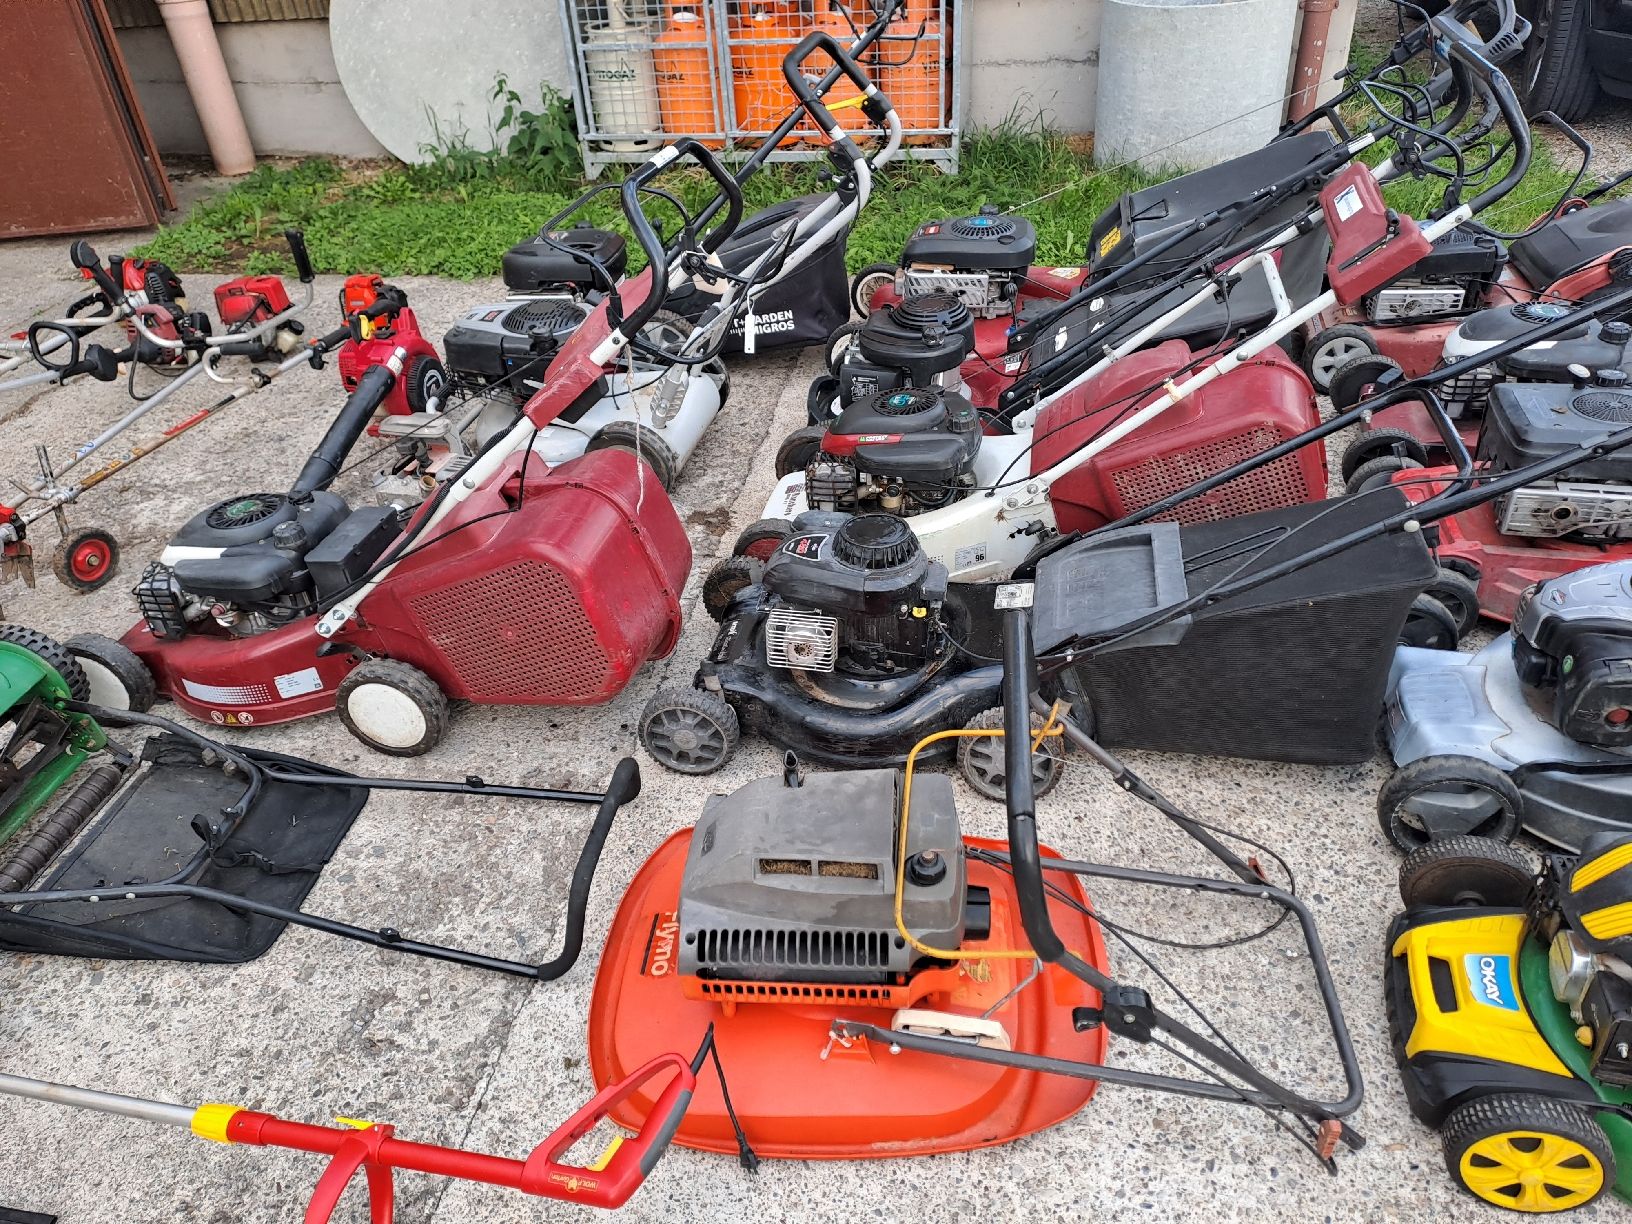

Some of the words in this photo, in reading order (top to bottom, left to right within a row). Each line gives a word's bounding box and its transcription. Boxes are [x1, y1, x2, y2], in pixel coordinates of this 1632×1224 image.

[593, 62, 636, 80] VITOGAZ
[754, 310, 794, 325] ARDEN
[1480, 957, 1504, 1005] OKAY
